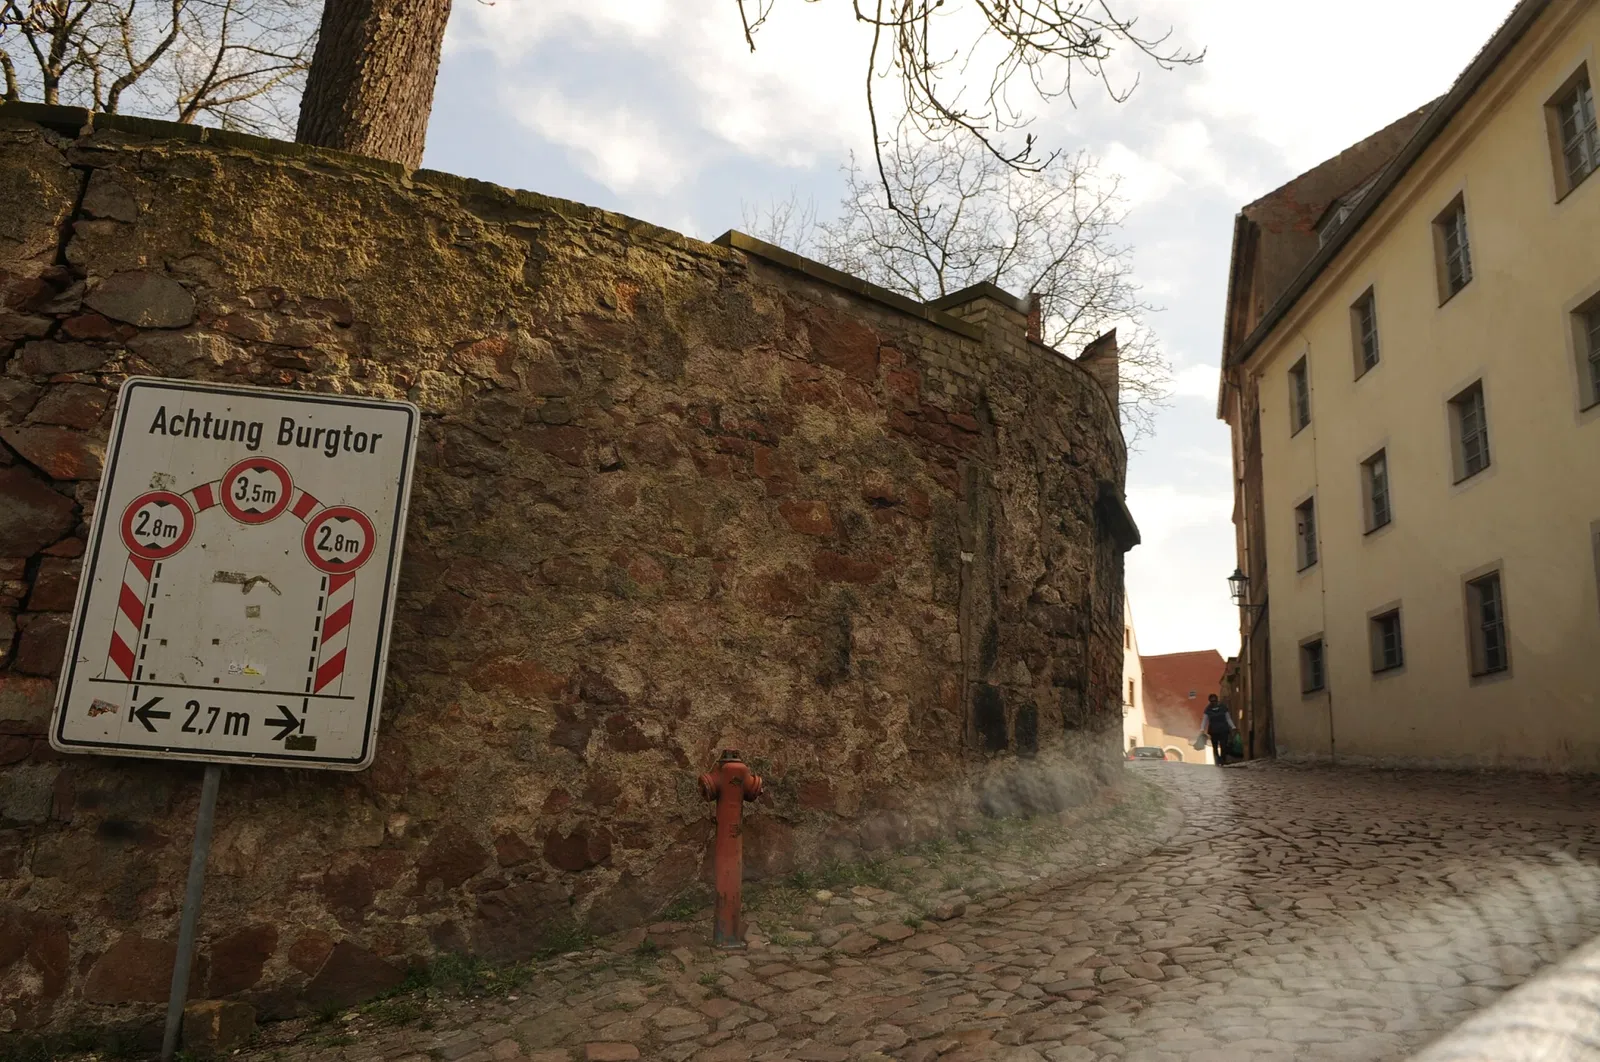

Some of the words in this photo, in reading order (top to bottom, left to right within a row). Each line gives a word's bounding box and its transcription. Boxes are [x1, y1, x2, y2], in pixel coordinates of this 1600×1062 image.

[148, 405, 264, 452] Achtung
[276, 416, 383, 459] Burgtor
[234, 476, 277, 504] 3,5m
[134, 510, 178, 539] 2,8m
[316, 525, 360, 554] 2,8m
